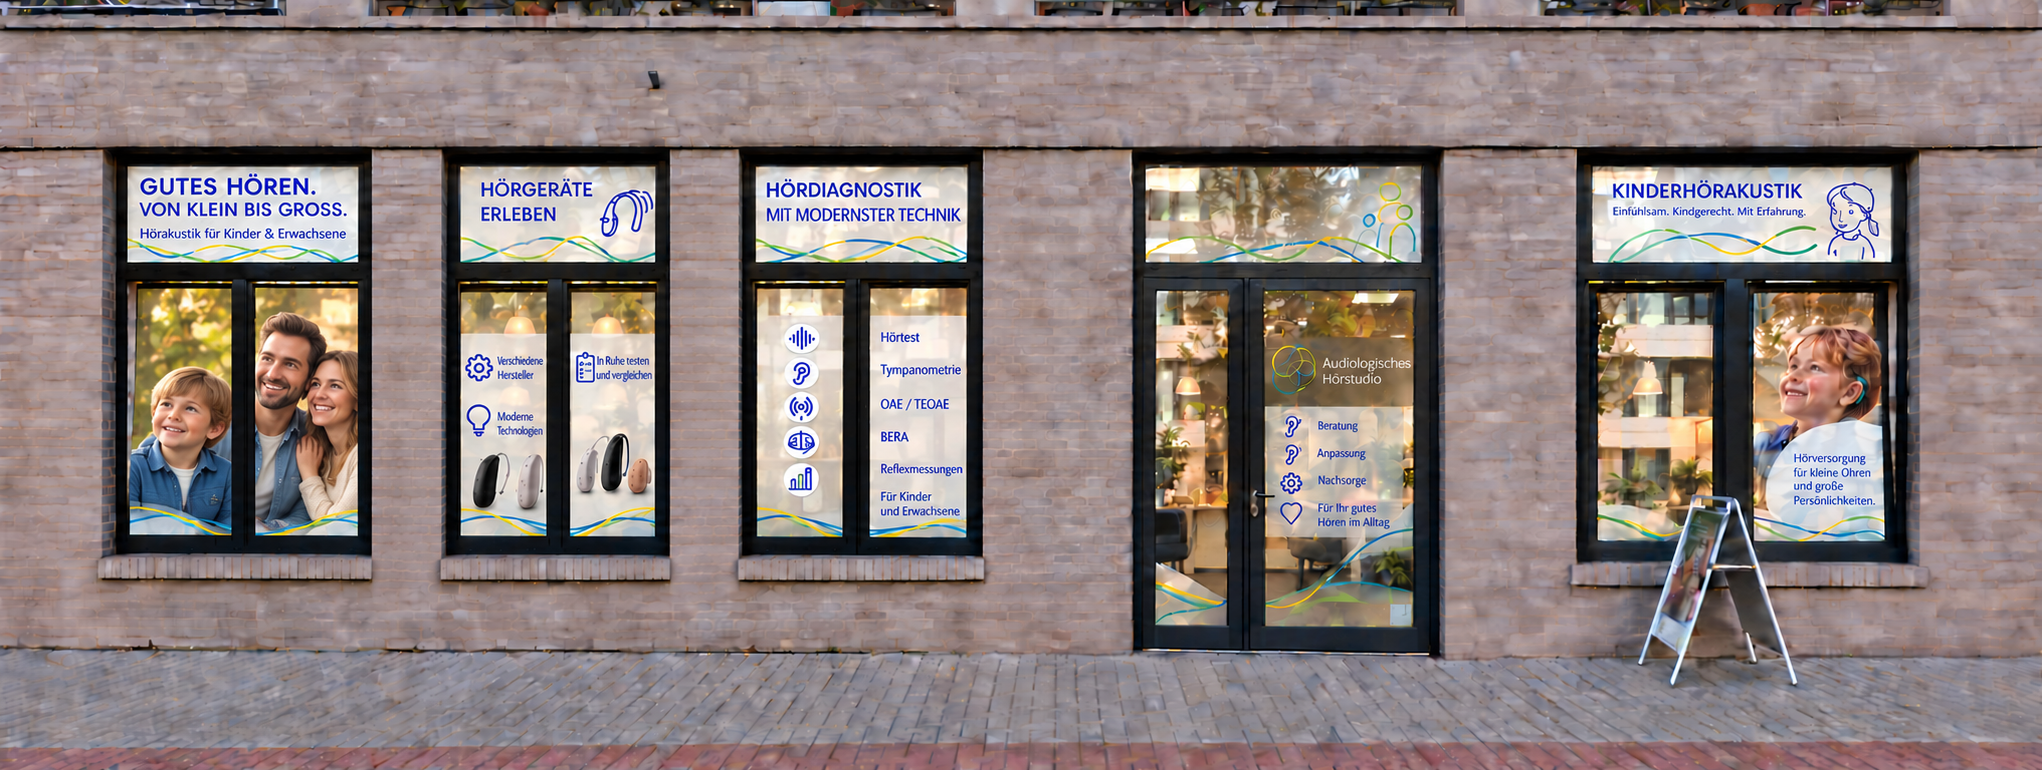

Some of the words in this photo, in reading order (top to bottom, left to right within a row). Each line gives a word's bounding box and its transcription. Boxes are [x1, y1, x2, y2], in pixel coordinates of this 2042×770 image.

[139, 177, 216, 196] GUTES
[228, 173, 315, 195] HÖREN.
[481, 178, 592, 197] HÖRGERÄTE
[767, 179, 921, 197] HÖRDIAGNOSTIK
[1613, 180, 1802, 198] KINDERHÖRAKUSTIK
[139, 202, 181, 216] VON
[187, 203, 238, 216] KLEIN
[244, 202, 272, 216] BIS
[278, 202, 348, 216] GROSS.
[480, 207, 556, 221] ERLEBEN
[766, 208, 792, 221] MIT
[795, 208, 896, 221] MODERNSTER
[897, 208, 962, 221] TECHNIK
[1672, 206, 1735, 219] Kindgerecht.
[1737, 206, 1754, 216] Mit
[1756, 206, 1806, 219] Erfahrung.
[140, 227, 202, 240] Hörakustik
[204, 227, 221, 239] für
[224, 227, 262, 240] Kinder
[264, 227, 275, 240] &
[278, 227, 347, 240] Erwachsene
[880, 331, 920, 343] Hörtest
[496, 355, 544, 366] Verschiedene
[596, 356, 605, 366] In
[605, 355, 626, 366] Ruhe
[626, 357, 650, 366] testen
[1322, 357, 1412, 371] Audiologisches
[497, 369, 534, 380] Hersteller
[596, 370, 611, 380] und
[611, 370, 653, 383] vergleichen
[880, 364, 962, 377] Tympanometrie
[880, 398, 904, 410] OAE
[913, 398, 950, 410] TEOAE
[497, 411, 534, 422] Moderne
[497, 425, 543, 438] Technologien
[1317, 420, 1359, 433] Beratung
[880, 431, 910, 443] BERA
[1316, 448, 1367, 461] Anpassung
[1793, 453, 1867, 466] Hörversorgung
[880, 463, 963, 476] Reflexmessungen
[1793, 467, 1808, 478] für
[1810, 467, 1839, 478] kleine
[1841, 467, 1871, 478] Ohren
[1317, 476, 1367, 487] Nachsorge
[1793, 480, 1813, 491] und
[1814, 481, 1844, 493] große
[880, 491, 898, 502] Für
[899, 491, 932, 502] Kinder
[1793, 495, 1876, 506] Persönlichkeiten.
[880, 505, 900, 517] und
[902, 505, 961, 517] Erwachsene
[1317, 502, 1334, 513] Für
[1335, 502, 1349, 513] Ihr
[1350, 504, 1377, 516] gutes
[1348, 517, 1361, 527] im
[1362, 517, 1391, 529] Alltag
